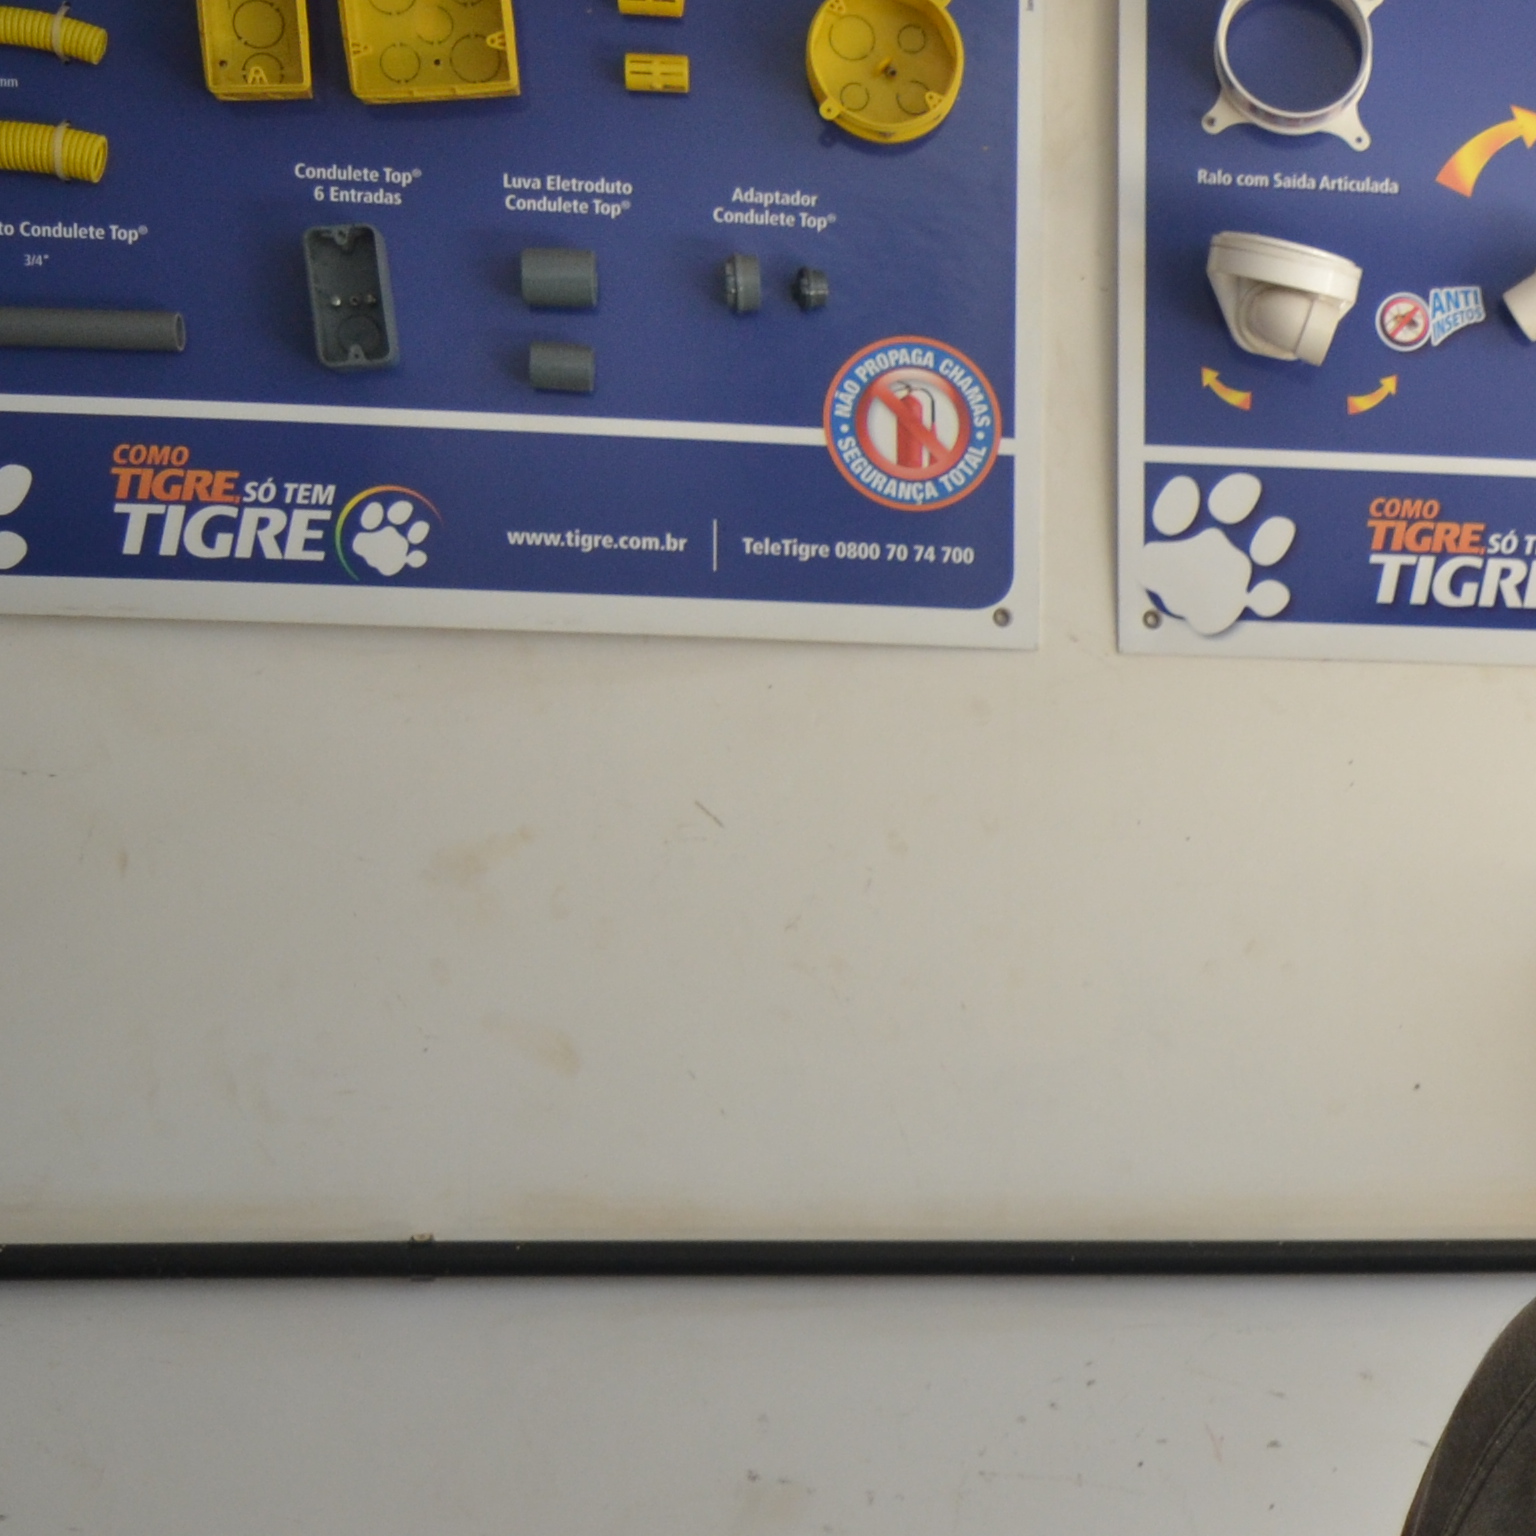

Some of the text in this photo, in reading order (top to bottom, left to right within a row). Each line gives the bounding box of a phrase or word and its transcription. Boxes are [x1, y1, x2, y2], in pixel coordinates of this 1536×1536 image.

[295, 163, 379, 183] Condulete
[503, 173, 633, 196] Luva Eletroduto
[1197, 169, 1233, 186] Ralo
[1237, 173, 1269, 188] com
[1319, 175, 1399, 195] Articulada
[314, 186, 402, 205] 6 Entradas
[505, 194, 589, 214] Condulete
[732, 187, 818, 208] Adaptador
[713, 206, 795, 227] Condulete
[20, 221, 105, 240] Condulete
[1432, 289, 1480, 319] ANTI
[834, 348, 991, 428] NÃO PROPAGA CHAMAS
[113, 443, 190, 467] COMO
[836, 436, 988, 506] SEGURANÇA TOTAL
[243, 477, 277, 503] SÓ
[284, 482, 337, 506] TEM
[1369, 497, 1441, 520] COMO
[114, 503, 332, 562] TIGRE
[507, 530, 688, 553] www.tigre.com.br
[1487, 529, 1519, 556] SÓ
[742, 536, 975, 565] TeleTigre 0800 70 74 700
